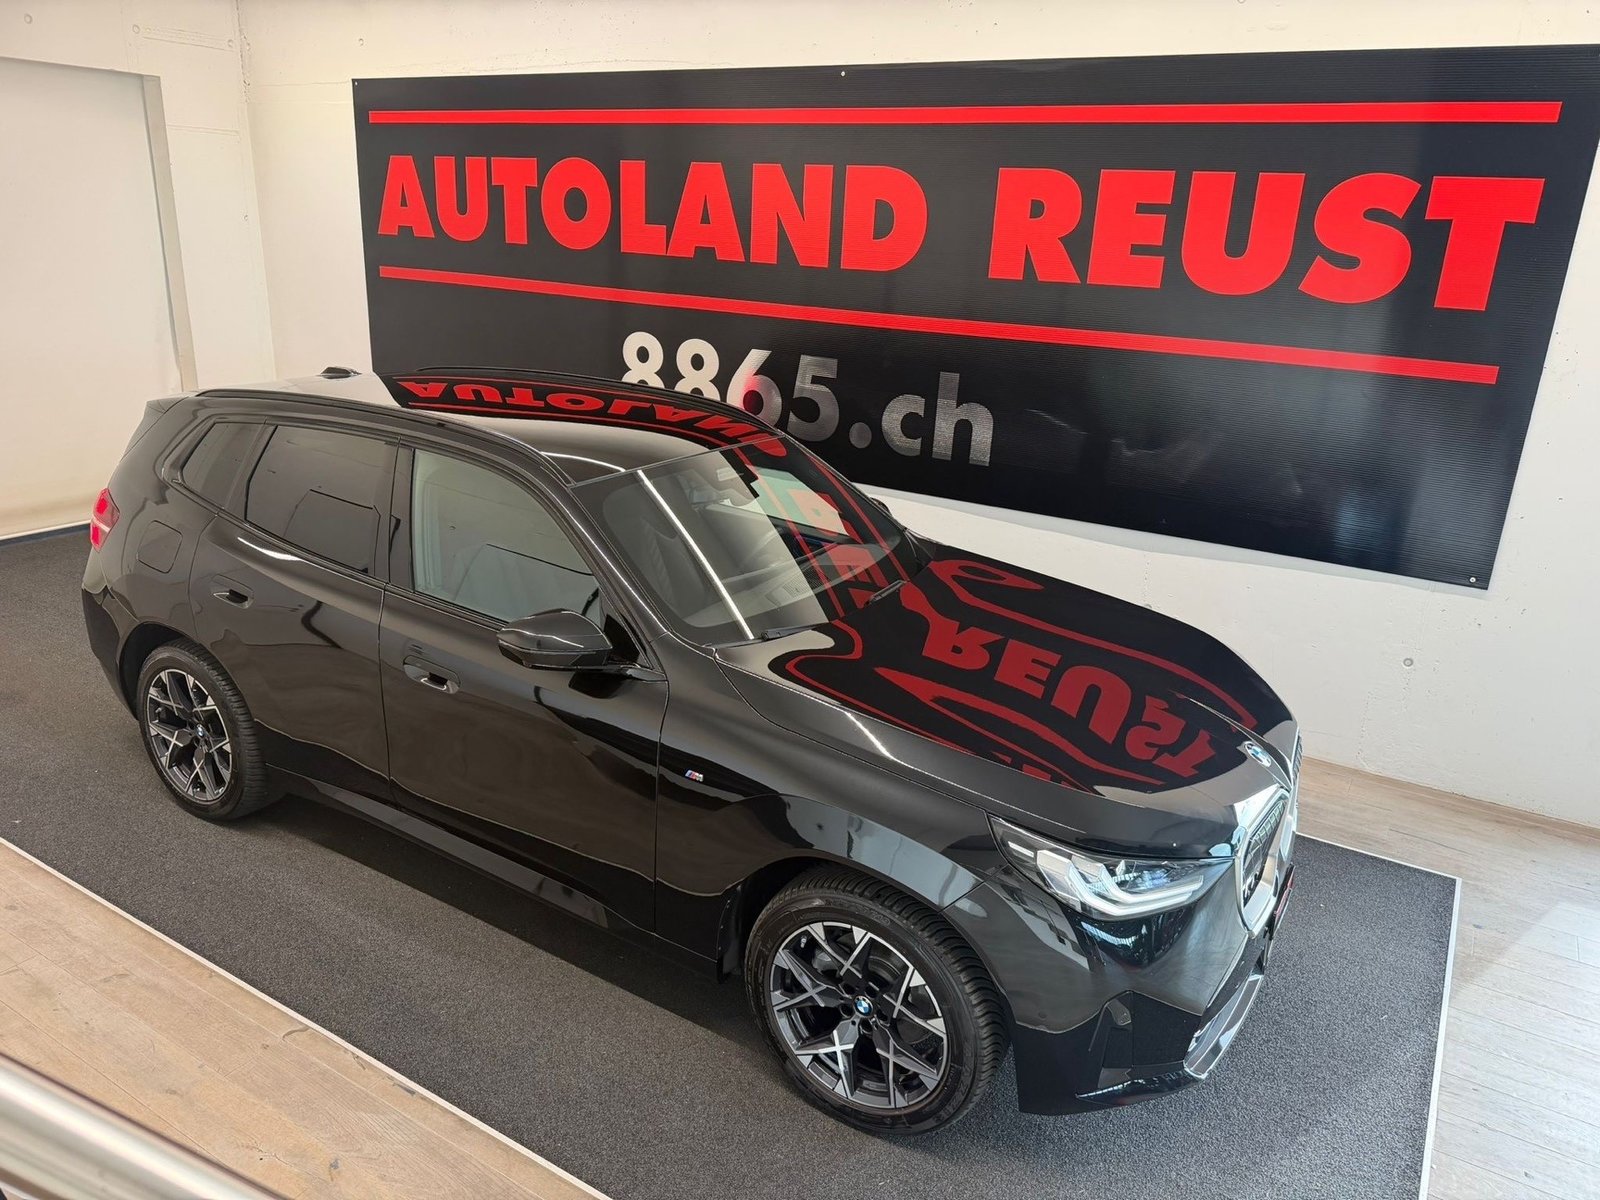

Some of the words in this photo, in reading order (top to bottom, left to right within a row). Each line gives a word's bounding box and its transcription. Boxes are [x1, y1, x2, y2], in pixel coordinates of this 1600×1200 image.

[379, 155, 928, 272] AUTOLAND
[988, 167, 1545, 311] REUST
[621, 331, 995, 467] 8865.ch
